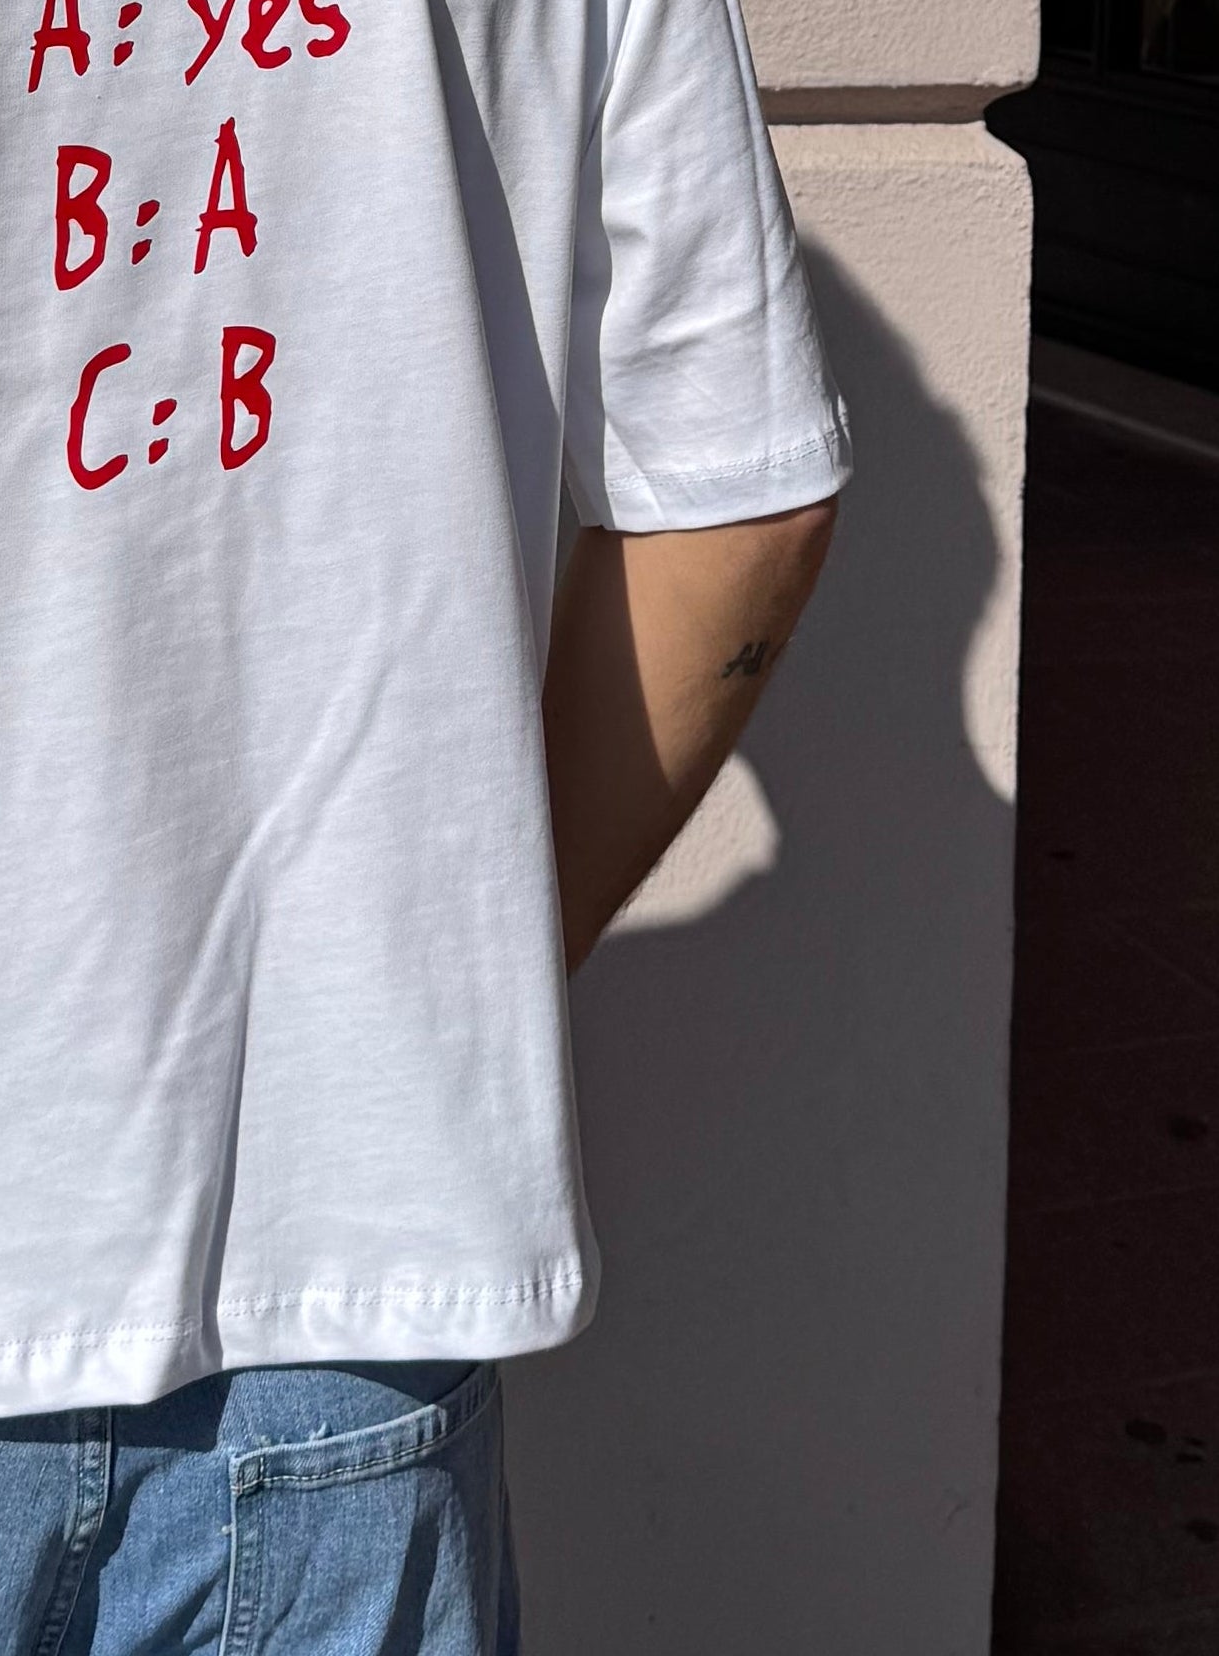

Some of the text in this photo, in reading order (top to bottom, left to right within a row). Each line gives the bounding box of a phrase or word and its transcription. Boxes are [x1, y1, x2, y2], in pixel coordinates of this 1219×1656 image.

[54, 117, 258, 292] B: A
[66, 326, 276, 491] C: B
